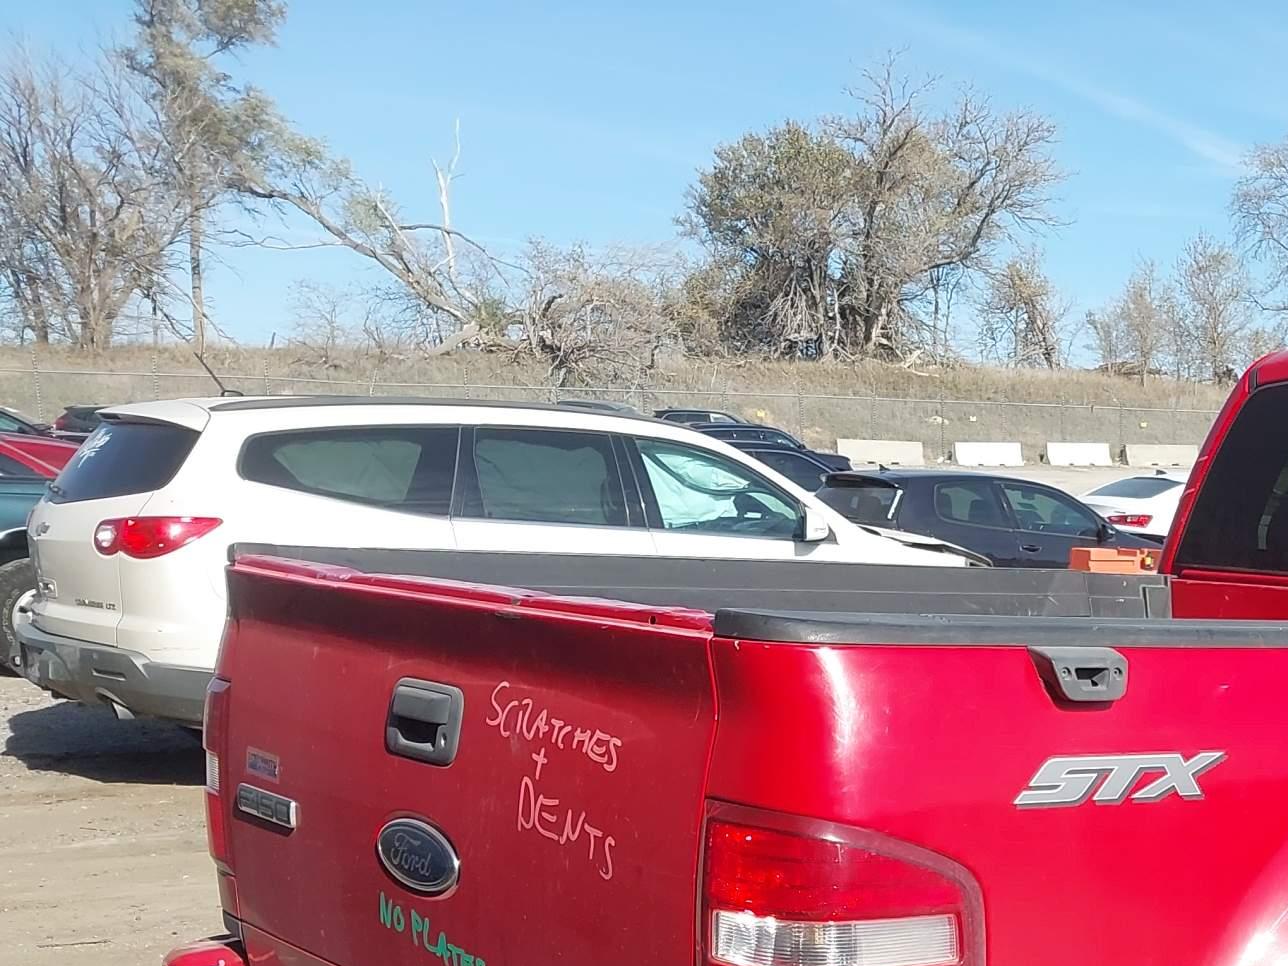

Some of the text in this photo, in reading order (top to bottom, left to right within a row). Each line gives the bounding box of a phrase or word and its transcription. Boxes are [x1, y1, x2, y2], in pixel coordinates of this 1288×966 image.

[486, 681, 622, 772] SCRATCHES
[1013, 750, 1227, 806] STX
[390, 832, 432, 877] Ford
[517, 776, 616, 880] DENTS
[379, 891, 405, 932] NO
